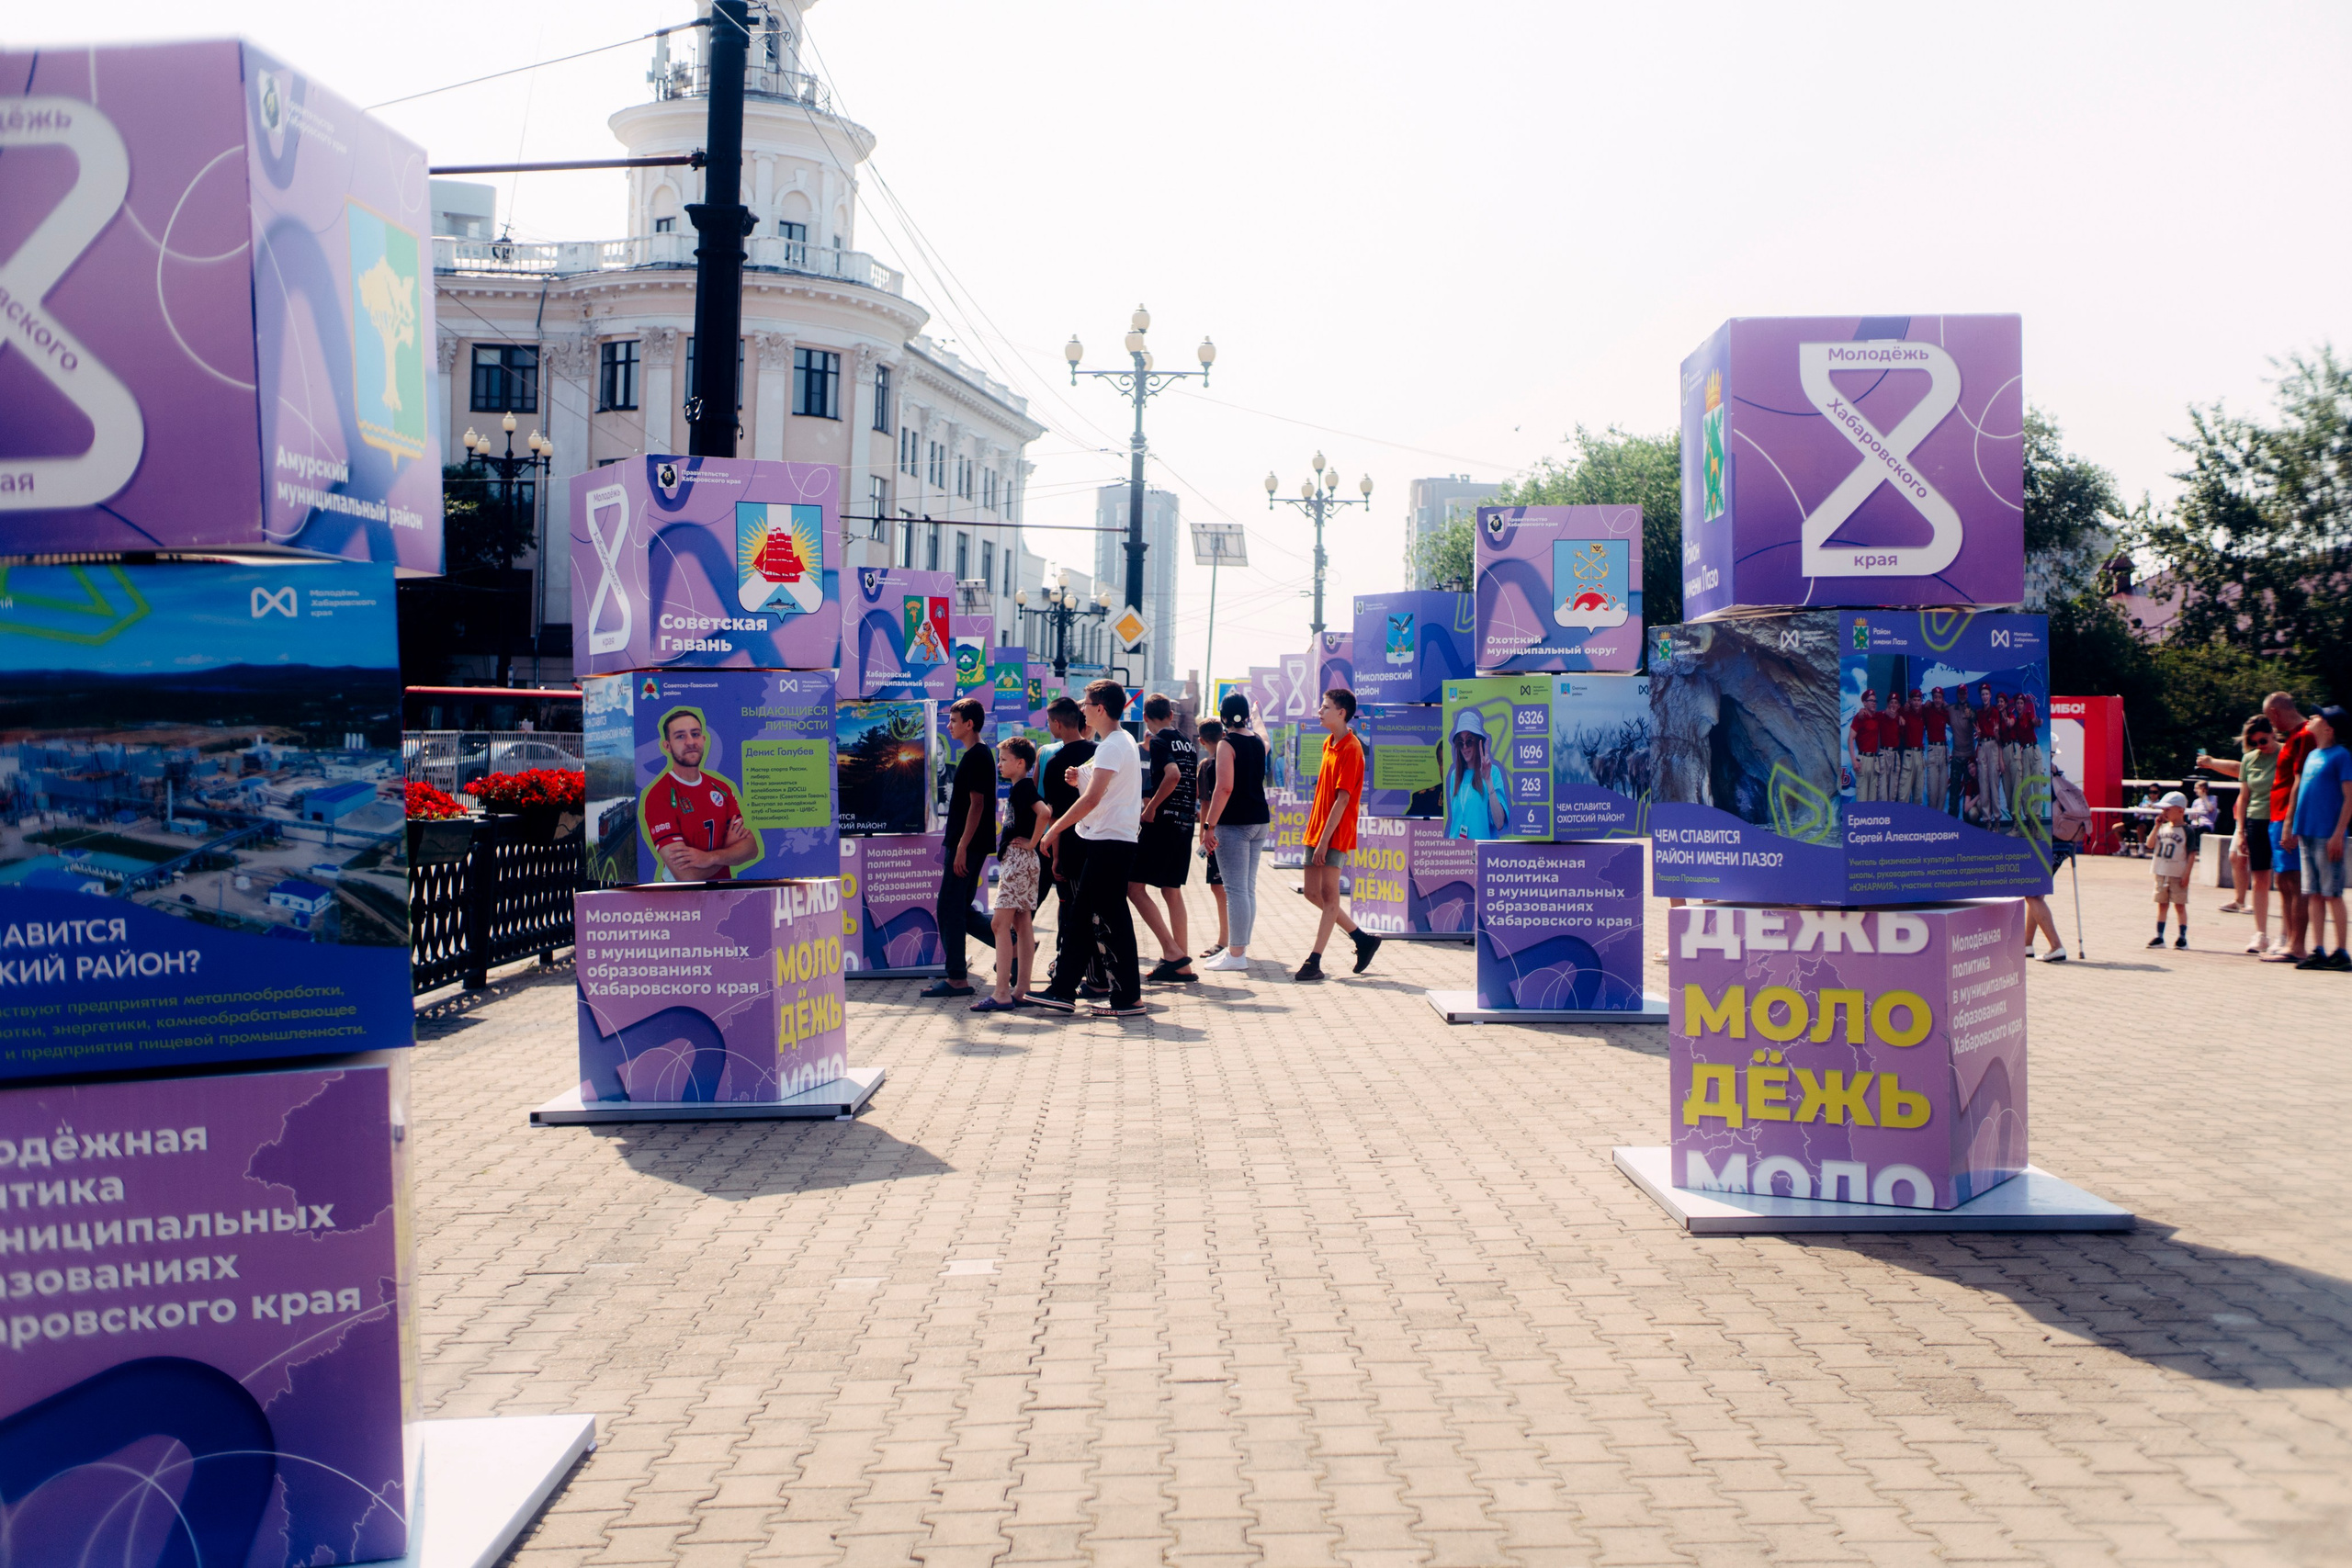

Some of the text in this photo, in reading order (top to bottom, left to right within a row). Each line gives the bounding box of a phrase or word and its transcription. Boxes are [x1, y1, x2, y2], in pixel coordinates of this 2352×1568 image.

[0, 103, 72, 135] ёжь
[1828, 346, 1929, 362] Молодёжь
[1826, 398, 1928, 500] Хабаровского
[277, 445, 349, 483] Амурский
[681, 469, 729, 478] Правительство
[681, 476, 725, 484] Хабаровского
[277, 481, 423, 531] муниципальный район
[1853, 553, 1898, 569] края
[1702, 564, 1719, 593] Лазо
[311, 599, 377, 607] Хабаровского
[660, 614, 768, 632] Советская
[1873, 627, 1891, 636] Район
[660, 636, 732, 653] Гавань
[1487, 634, 1542, 645] Охотский
[1487, 645, 1617, 657] муниципальный округ
[865, 670, 911, 682] Хабаровский
[1354, 669, 1413, 682] Николаевский
[662, 682, 718, 691] Советско-Гаванский
[865, 678, 944, 689] муниципальный район
[662, 689, 682, 697] район
[1355, 686, 1379, 697] район
[741, 705, 828, 718] ВЫДАЮЩИЕСЯ
[1518, 710, 1544, 725] 6326
[764, 720, 828, 731] ЛИЧНОСТИ
[745, 746, 814, 760] Денис Голубев
[1519, 744, 1544, 760] 1696
[1521, 777, 1541, 792] 263
[1556, 802, 1611, 811] ЧЕМ СЛАВИТСЯ
[1527, 809, 1535, 823] 6
[1556, 811, 1625, 823] ОХОТСКИЙ РАЙОН?
[1848, 815, 1891, 827] Ермолов
[856, 821, 888, 829] РАЙОН?
[1655, 829, 1741, 844] ЧЕМ СЛАВИТСЯ
[1848, 830, 1959, 845] Сергей Александрович
[1414, 840, 1455, 849] политика
[2157, 842, 2176, 859] 10
[867, 847, 927, 859] Молодёжная
[1353, 847, 1407, 872] МОЛО
[1656, 848, 1783, 867] РАЙОН ИМЕНИ ЛАЗО?
[1849, 852, 2031, 868] Учитель физической культуры Полетненской средней
[867, 860, 911, 869] политика
[1487, 857, 1586, 870] Молодёжная
[1414, 867, 1474, 878] Хабаровского
[1487, 874, 1559, 883] политика
[1657, 873, 1720, 884] Пещера Прощальная
[1849, 864, 2019, 881] школы, руководитель местного отделения ВВПОД
[867, 881, 932, 893] образованиях
[1352, 873, 1406, 903] ДЁЖЬ
[1849, 875, 2041, 893] «ЮНАРМИЯ», участник специальной военной операции
[868, 891, 932, 904] Хабаровского
[1487, 887, 1625, 902] в муниципальных
[1487, 900, 1594, 913] образованиях
[585, 908, 702, 924] Молодёжная
[1487, 915, 1633, 929] Хабаровского края
[2, 918, 127, 949] АВИТСЯ
[586, 928, 671, 942] политика
[1951, 928, 2001, 953] Молодёжная
[587, 944, 750, 964] в муниципальных
[776, 935, 841, 987] МОЛО
[0, 949, 201, 987] КИЙ РАЙОН?
[587, 964, 713, 981] образованиях
[1952, 955, 1991, 978] политика
[588, 981, 759, 998] Хабаровского края
[1953, 971, 2019, 1005] в муниципальных
[68, 984, 345, 1016] предприятия металлообработки,
[52, 1005, 356, 1037] энергетики, камнеобрабатывающее
[778, 989, 842, 1055] ДЁЖЬ
[1684, 983, 1933, 1048] МОЛО
[1953, 999, 2007, 1031] образованиях
[6, 1024, 367, 1060] и предприятия пищевой промышленности.
[1953, 1018, 2023, 1055] Хабаровского края
[1682, 1049, 1931, 1129] ДЁЖЬ
[0, 1287, 362, 1354] ровского края
